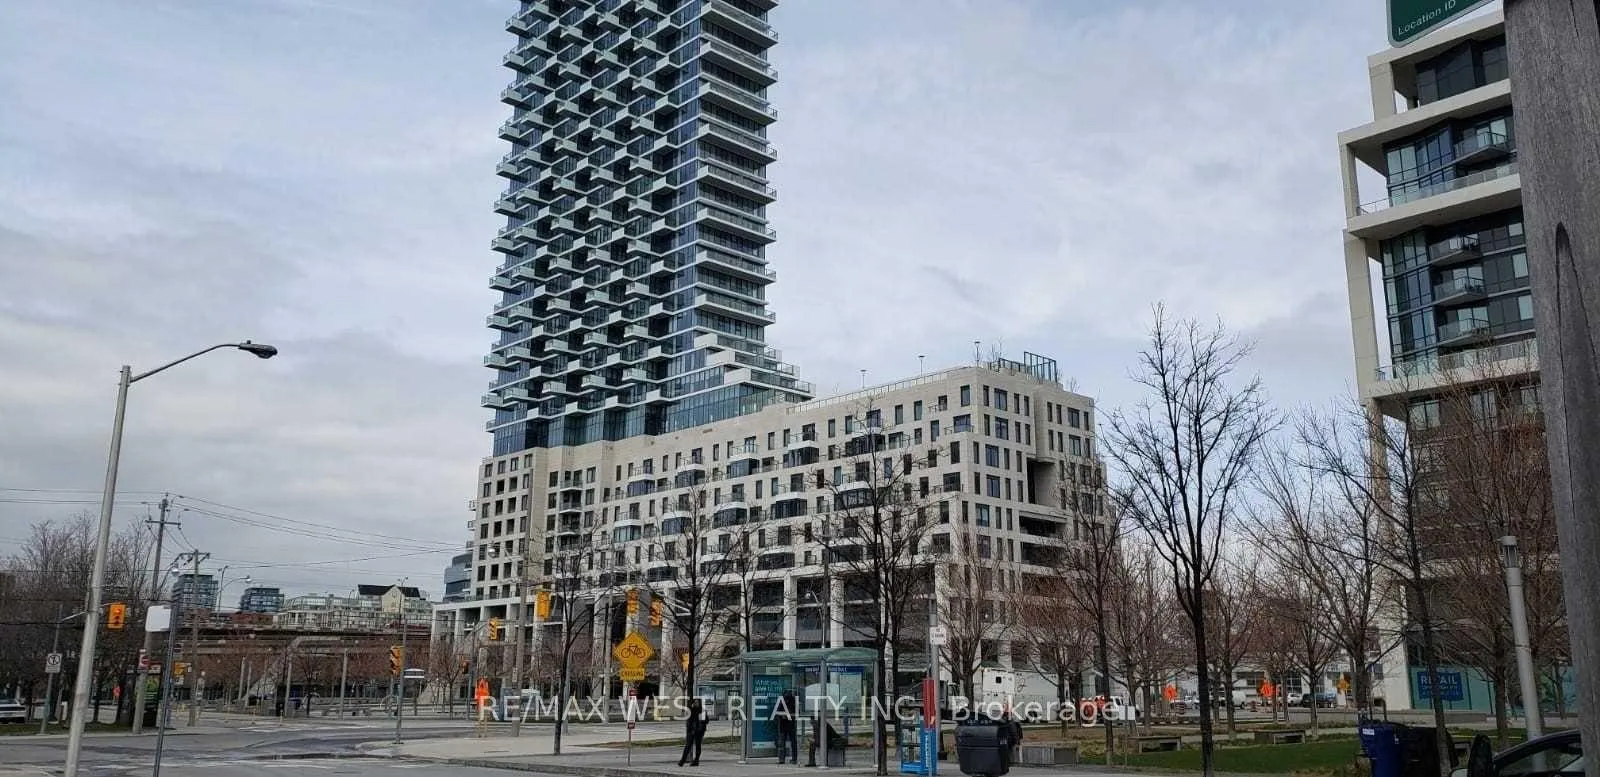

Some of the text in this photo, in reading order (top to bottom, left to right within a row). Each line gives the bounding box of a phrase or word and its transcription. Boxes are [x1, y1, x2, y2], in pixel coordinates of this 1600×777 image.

[1398, 0, 1456, 36] Location ID
[1420, 675, 1457, 685] RAIL
